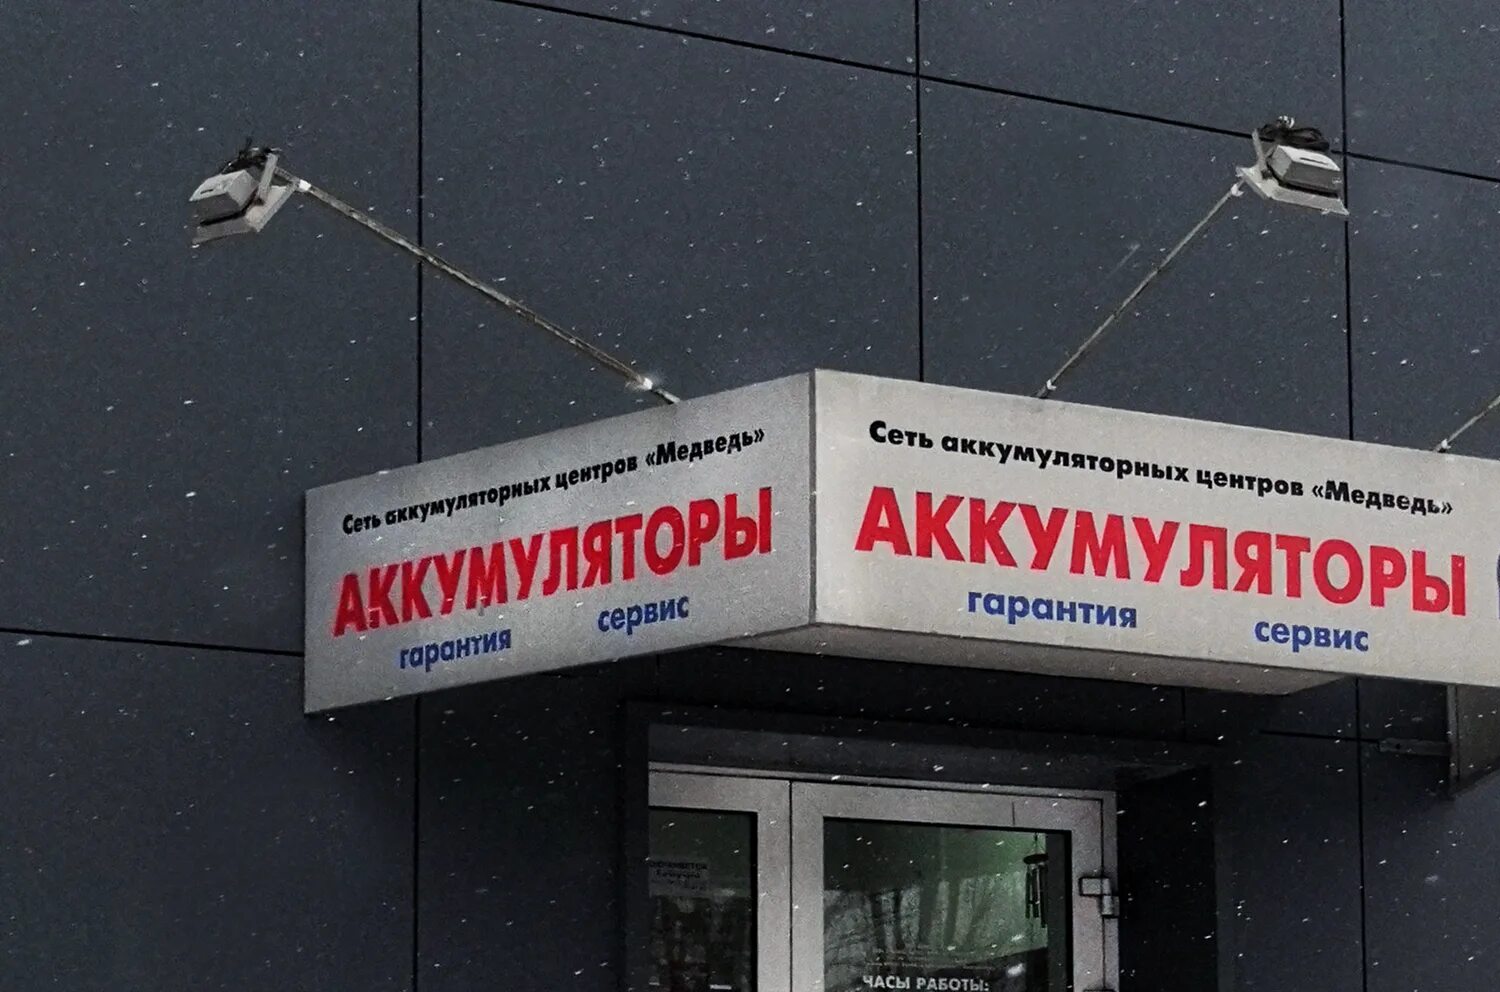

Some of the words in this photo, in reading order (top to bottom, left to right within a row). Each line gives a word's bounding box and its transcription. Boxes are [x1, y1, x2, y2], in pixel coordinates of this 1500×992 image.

[342, 513, 381, 536] Сеть
[385, 476, 551, 523] аккумуляторных
[555, 455, 638, 493] центров
[644, 428, 765, 466] «Медведь»
[868, 420, 934, 450] Сеть
[940, 434, 1190, 483] аккумуляторных
[1195, 468, 1304, 498] центров
[1311, 479, 1453, 516] «Медведь»
[332, 486, 773, 638] АККУМУЛЯТОРЫ
[854, 485, 1467, 617] АККУМУЛЯТОРЫ
[399, 628, 512, 672] гарантия
[597, 595, 690, 635] сервис
[967, 591, 1137, 628] гарантия
[1254, 620, 1370, 653] сервис
[862, 975, 911, 990] ЧАСЫ
[916, 977, 990, 992] РАБОТЫ:
